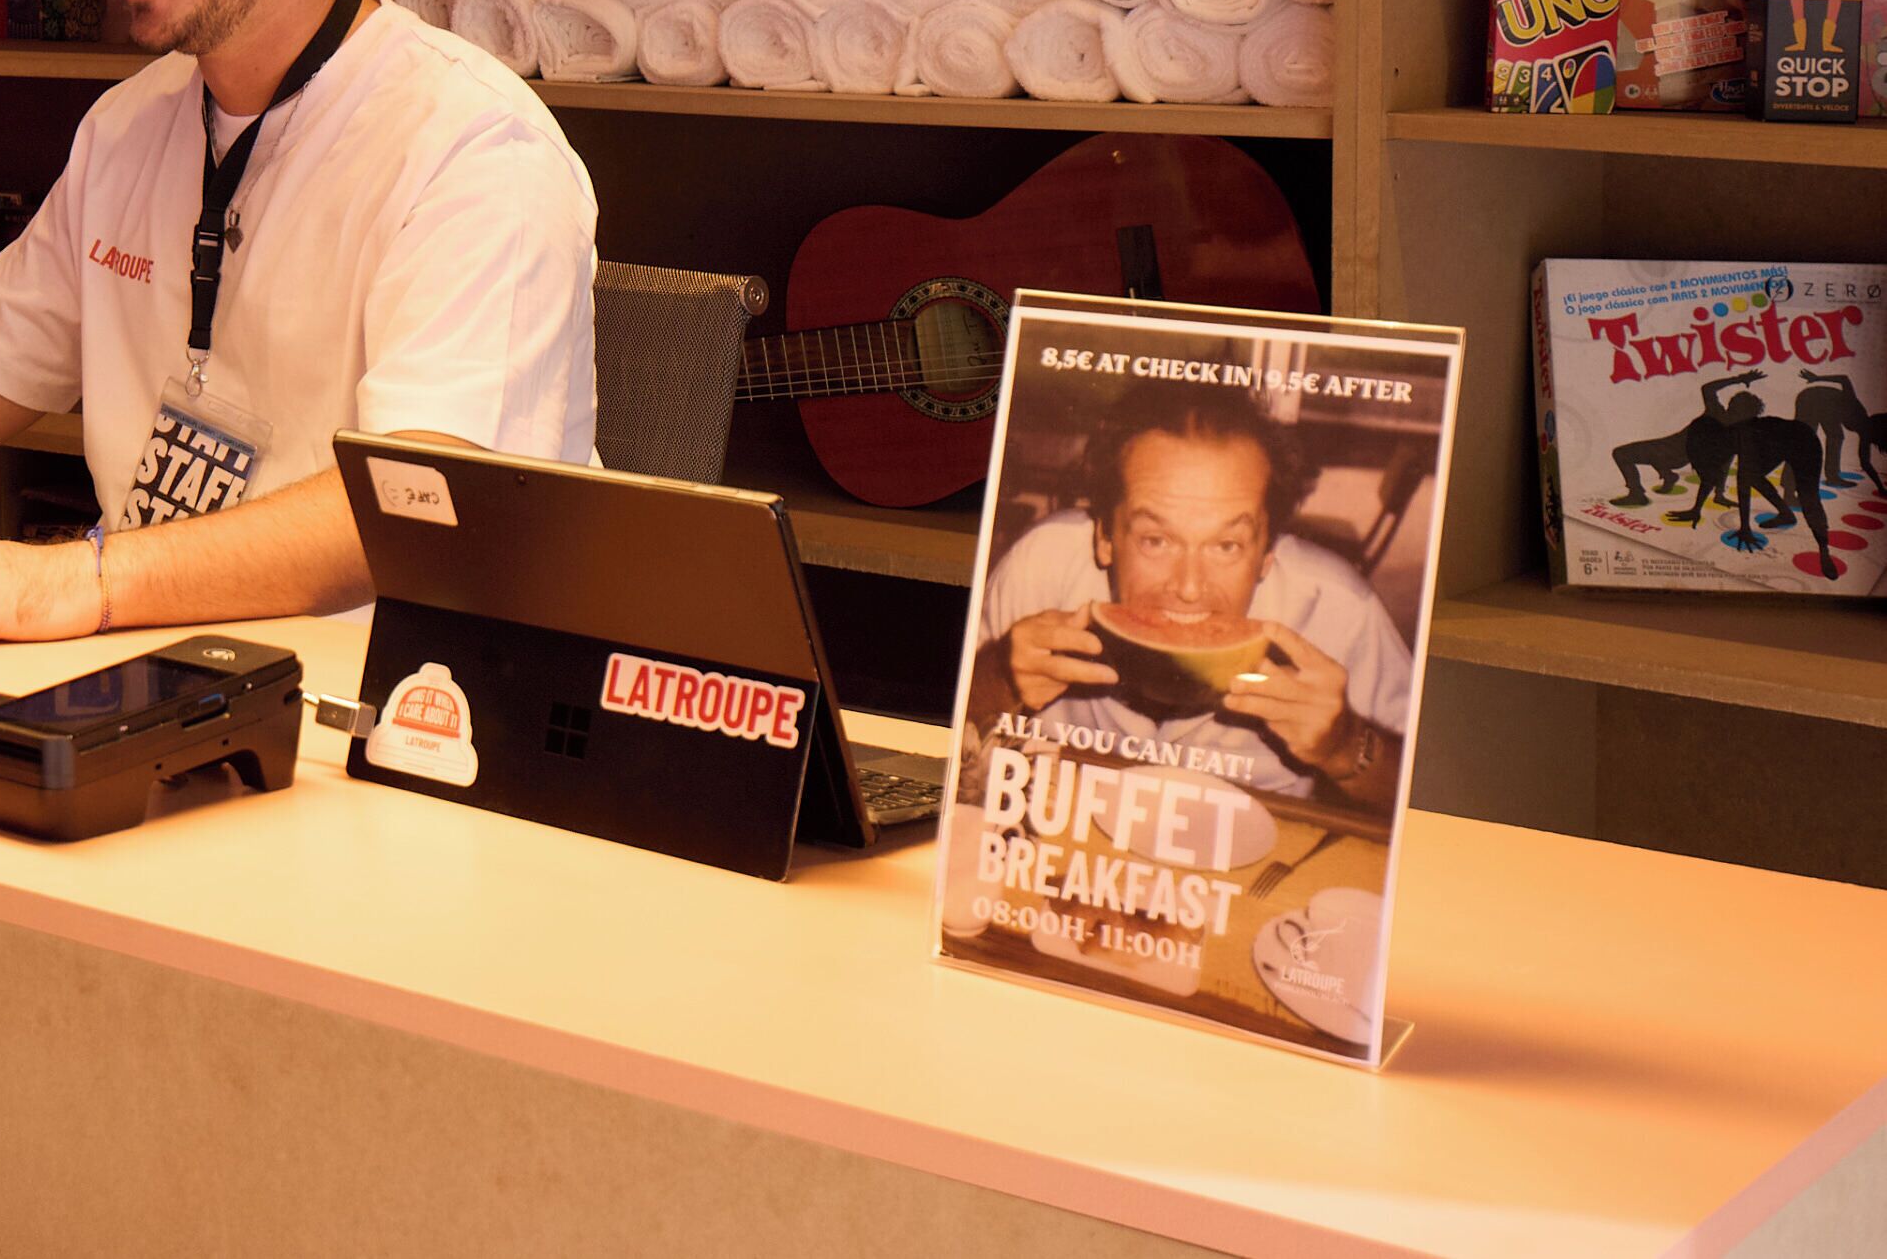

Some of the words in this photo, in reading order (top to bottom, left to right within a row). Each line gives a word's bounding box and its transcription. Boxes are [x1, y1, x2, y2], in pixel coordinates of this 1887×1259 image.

[1519, 69, 1531, 83] 3
[1541, 66, 1553, 81] 4
[1777, 57, 1846, 75] QUICK
[1775, 76, 1849, 98] STOP
[1565, 306, 1575, 314] O
[1579, 304, 1601, 316] jogo
[1605, 298, 1645, 310] clássico
[1647, 296, 1669, 304] com
[1671, 290, 1697, 301] MAIS
[1579, 292, 1609, 303] juego
[1649, 284, 1667, 292] con
[1681, 270, 1757, 288] MOVIMIENTOS
[1588, 300, 1863, 383] Twister
[1040, 347, 1091, 373] 8,5€
[1095, 354, 1131, 375] AT
[1133, 356, 1219, 384] CHECK
[1223, 365, 1253, 387] IN
[1266, 371, 1319, 395] 9,5€
[1323, 375, 1413, 404] AFTER
[1581, 504, 1661, 534] Twister
[606, 659, 801, 742] LATROUPE
[405, 736, 441, 753] LATROUPE
[994, 712, 1050, 743] ALL
[1054, 722, 1115, 754] YOU
[1120, 736, 1181, 764] CAN
[1185, 747, 1255, 780] EAT!
[984, 746, 1251, 872] BUFFET
[977, 830, 1243, 936] BREAKFAST
[1099, 923, 1202, 970] 11:00H
[1280, 966, 1345, 994] LATROUPE
